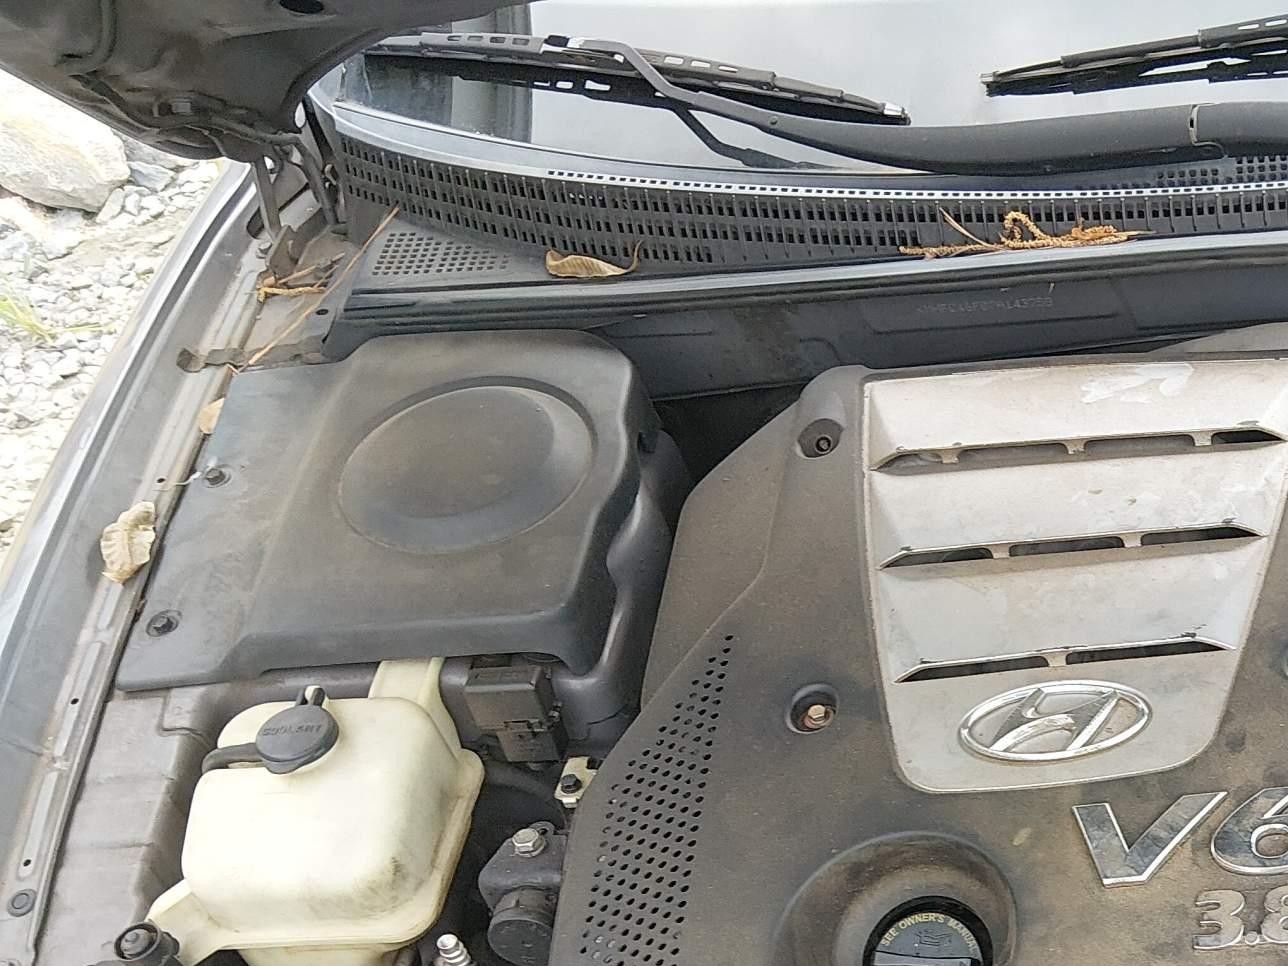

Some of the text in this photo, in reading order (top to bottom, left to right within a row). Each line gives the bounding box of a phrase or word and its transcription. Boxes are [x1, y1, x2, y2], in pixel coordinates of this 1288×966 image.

[264, 725, 322, 736] COOLANT
[881, 912, 979, 958] SEE OWNER'S MANUAL
